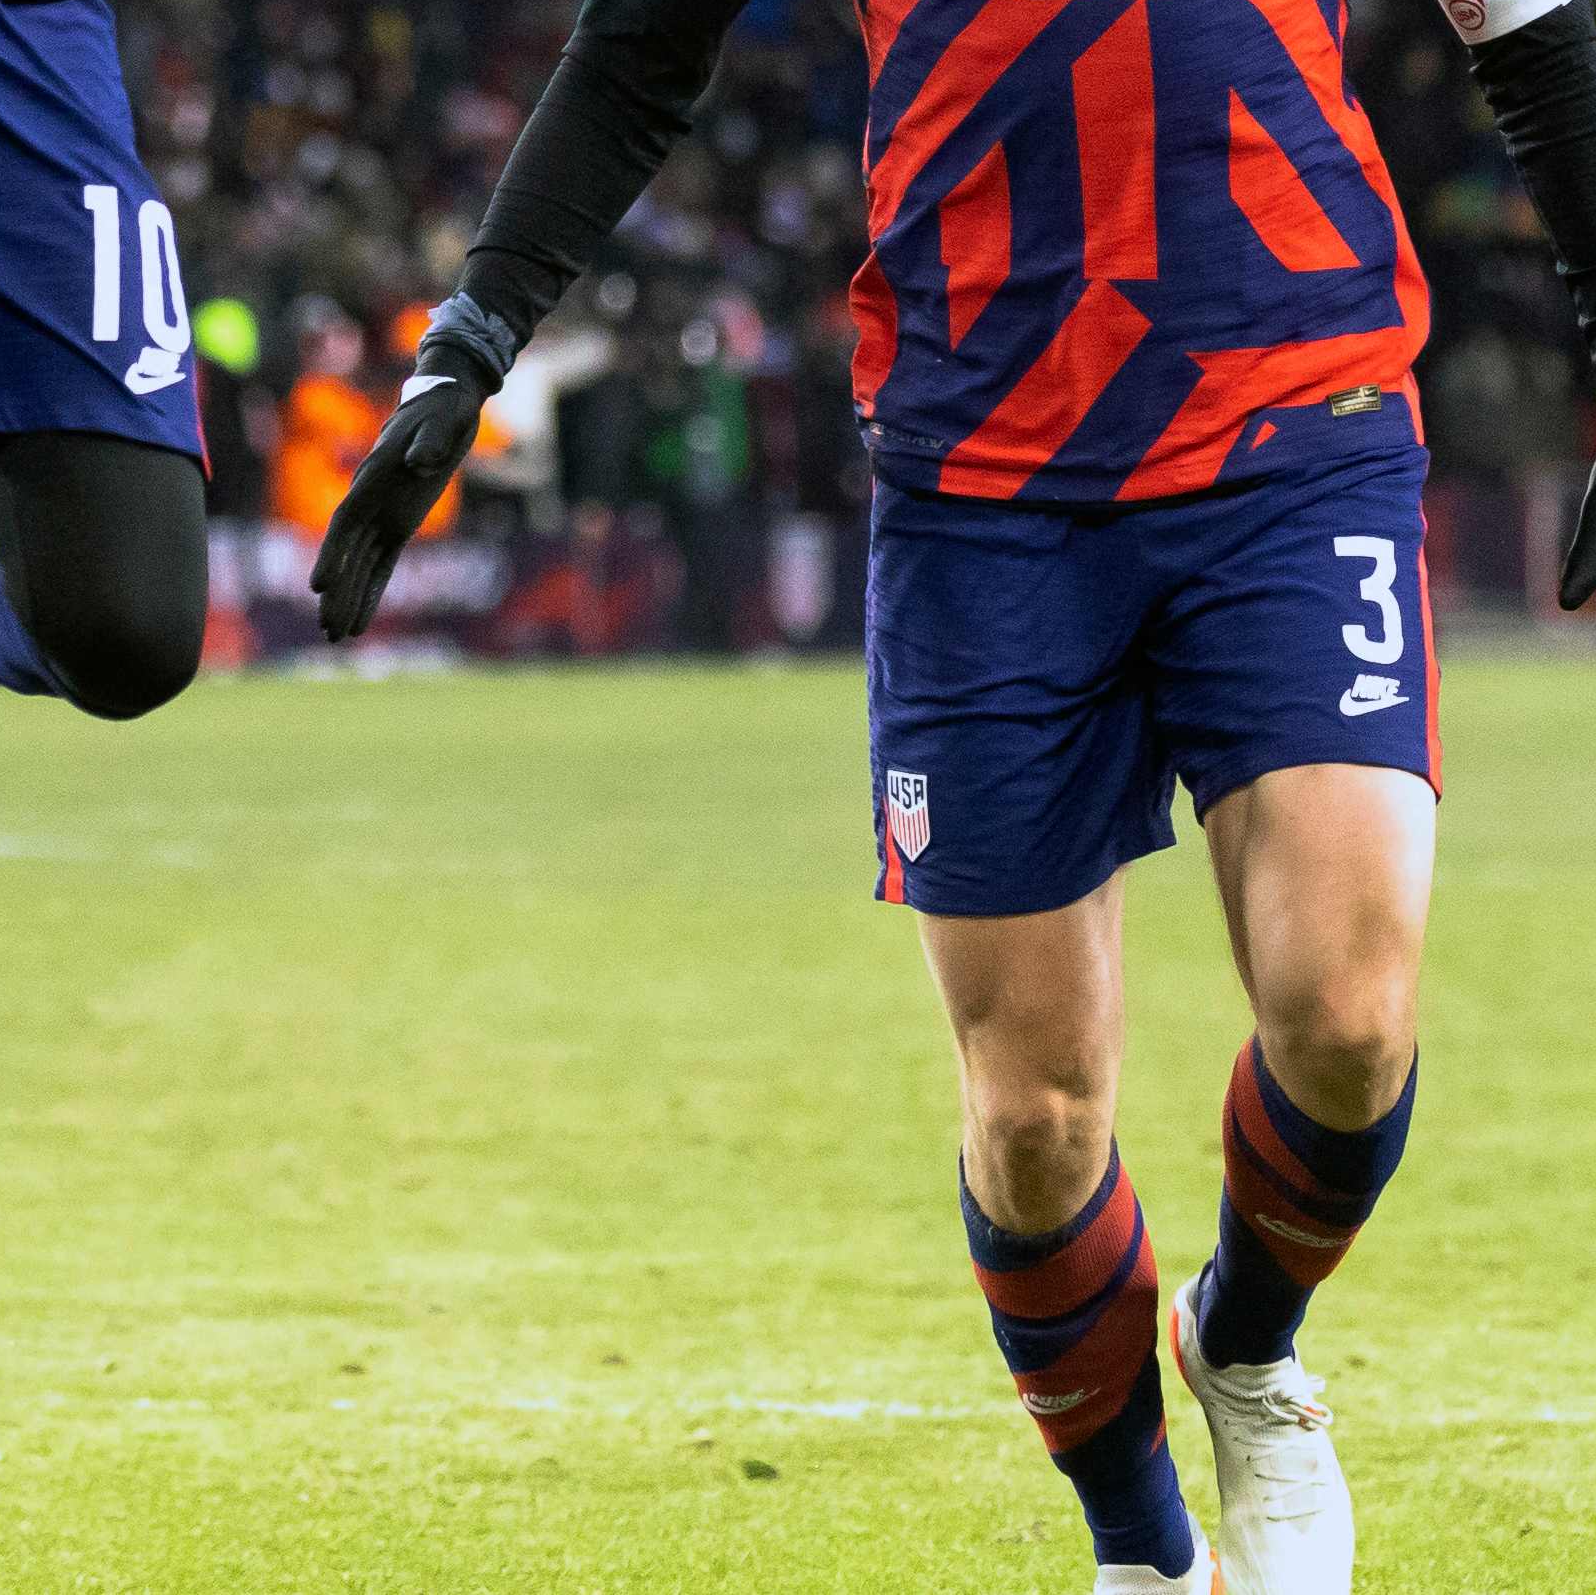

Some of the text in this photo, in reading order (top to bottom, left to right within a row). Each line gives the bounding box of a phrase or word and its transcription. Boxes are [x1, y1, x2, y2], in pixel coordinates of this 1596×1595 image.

[84, 184, 191, 354] 10
[1333, 535, 1405, 665] 3
[890, 775, 925, 810] USA
